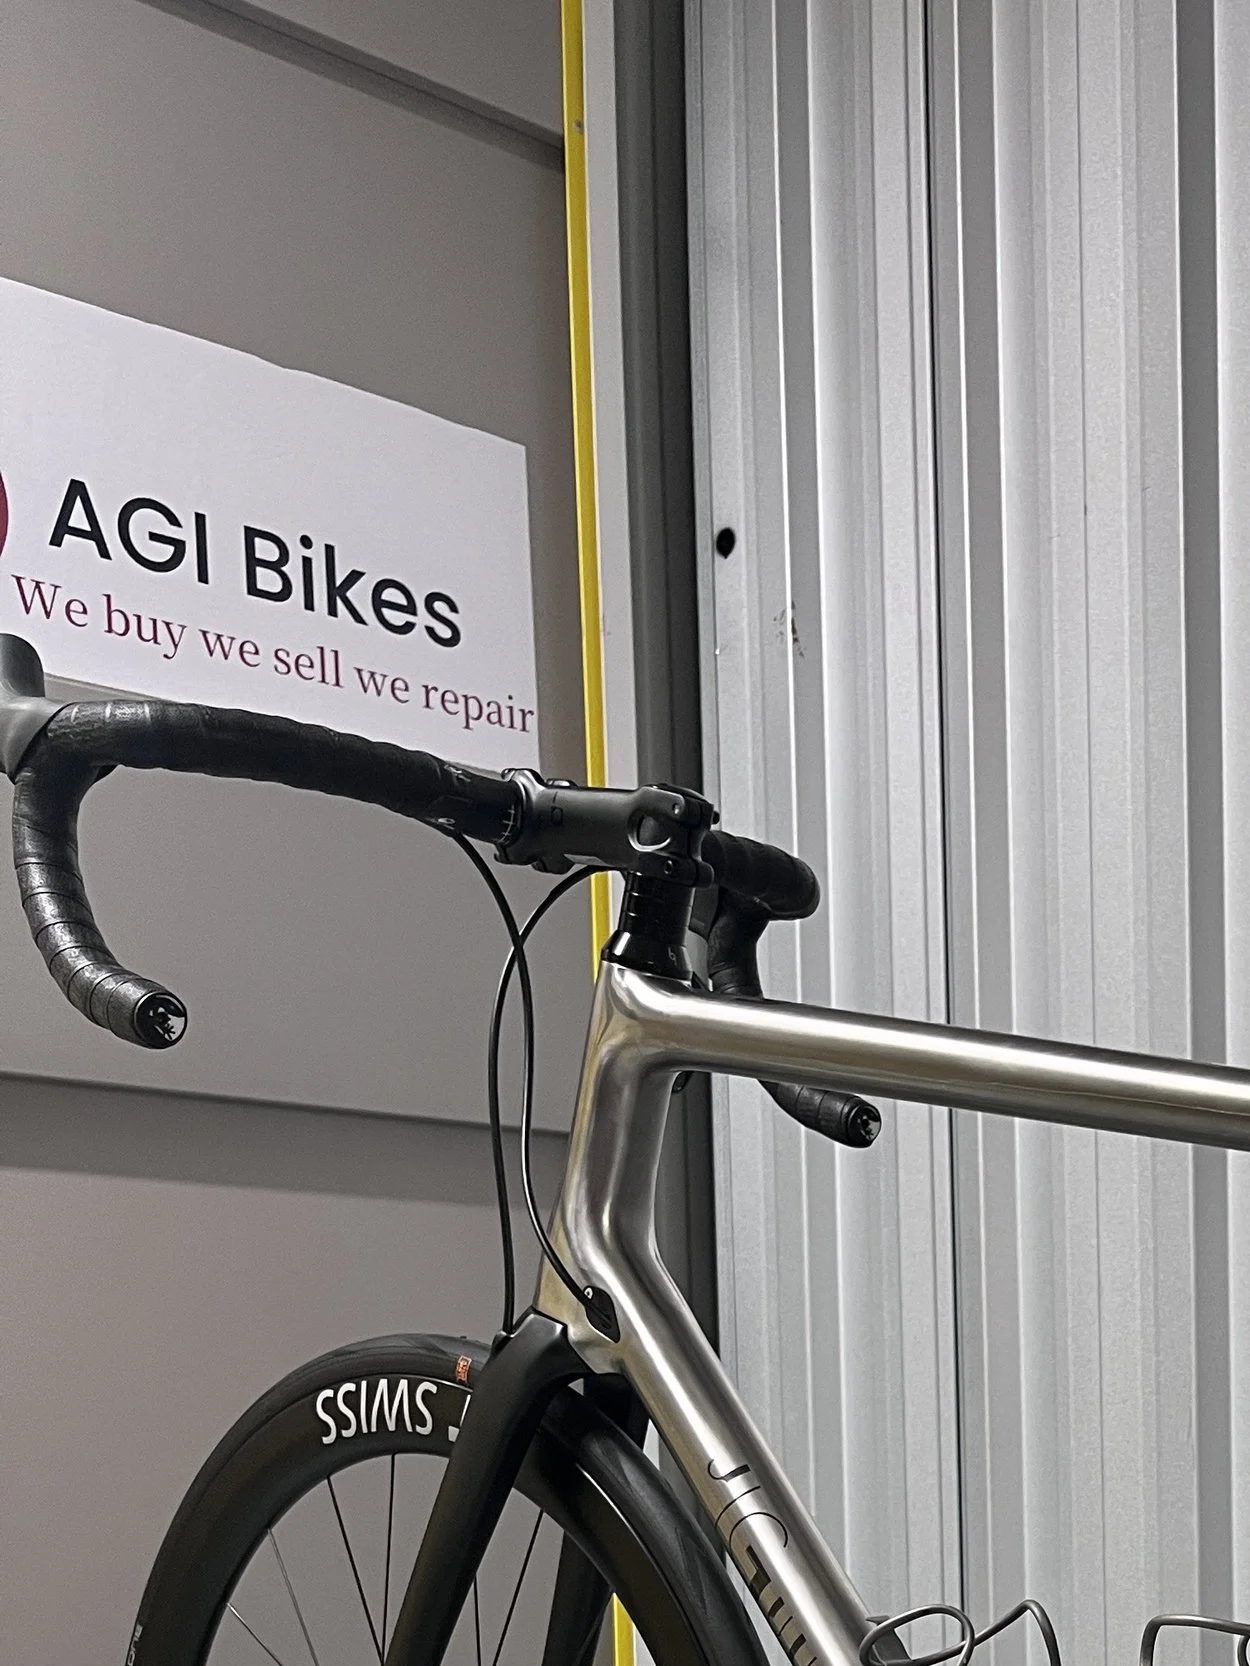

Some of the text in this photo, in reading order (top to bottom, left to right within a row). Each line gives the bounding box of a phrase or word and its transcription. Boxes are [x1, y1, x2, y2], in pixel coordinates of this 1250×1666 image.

[49, 478, 463, 649] AGI Bikes
[11, 574, 536, 733] We buy we sell we repair
[315, 1378, 438, 1444] SWISS
